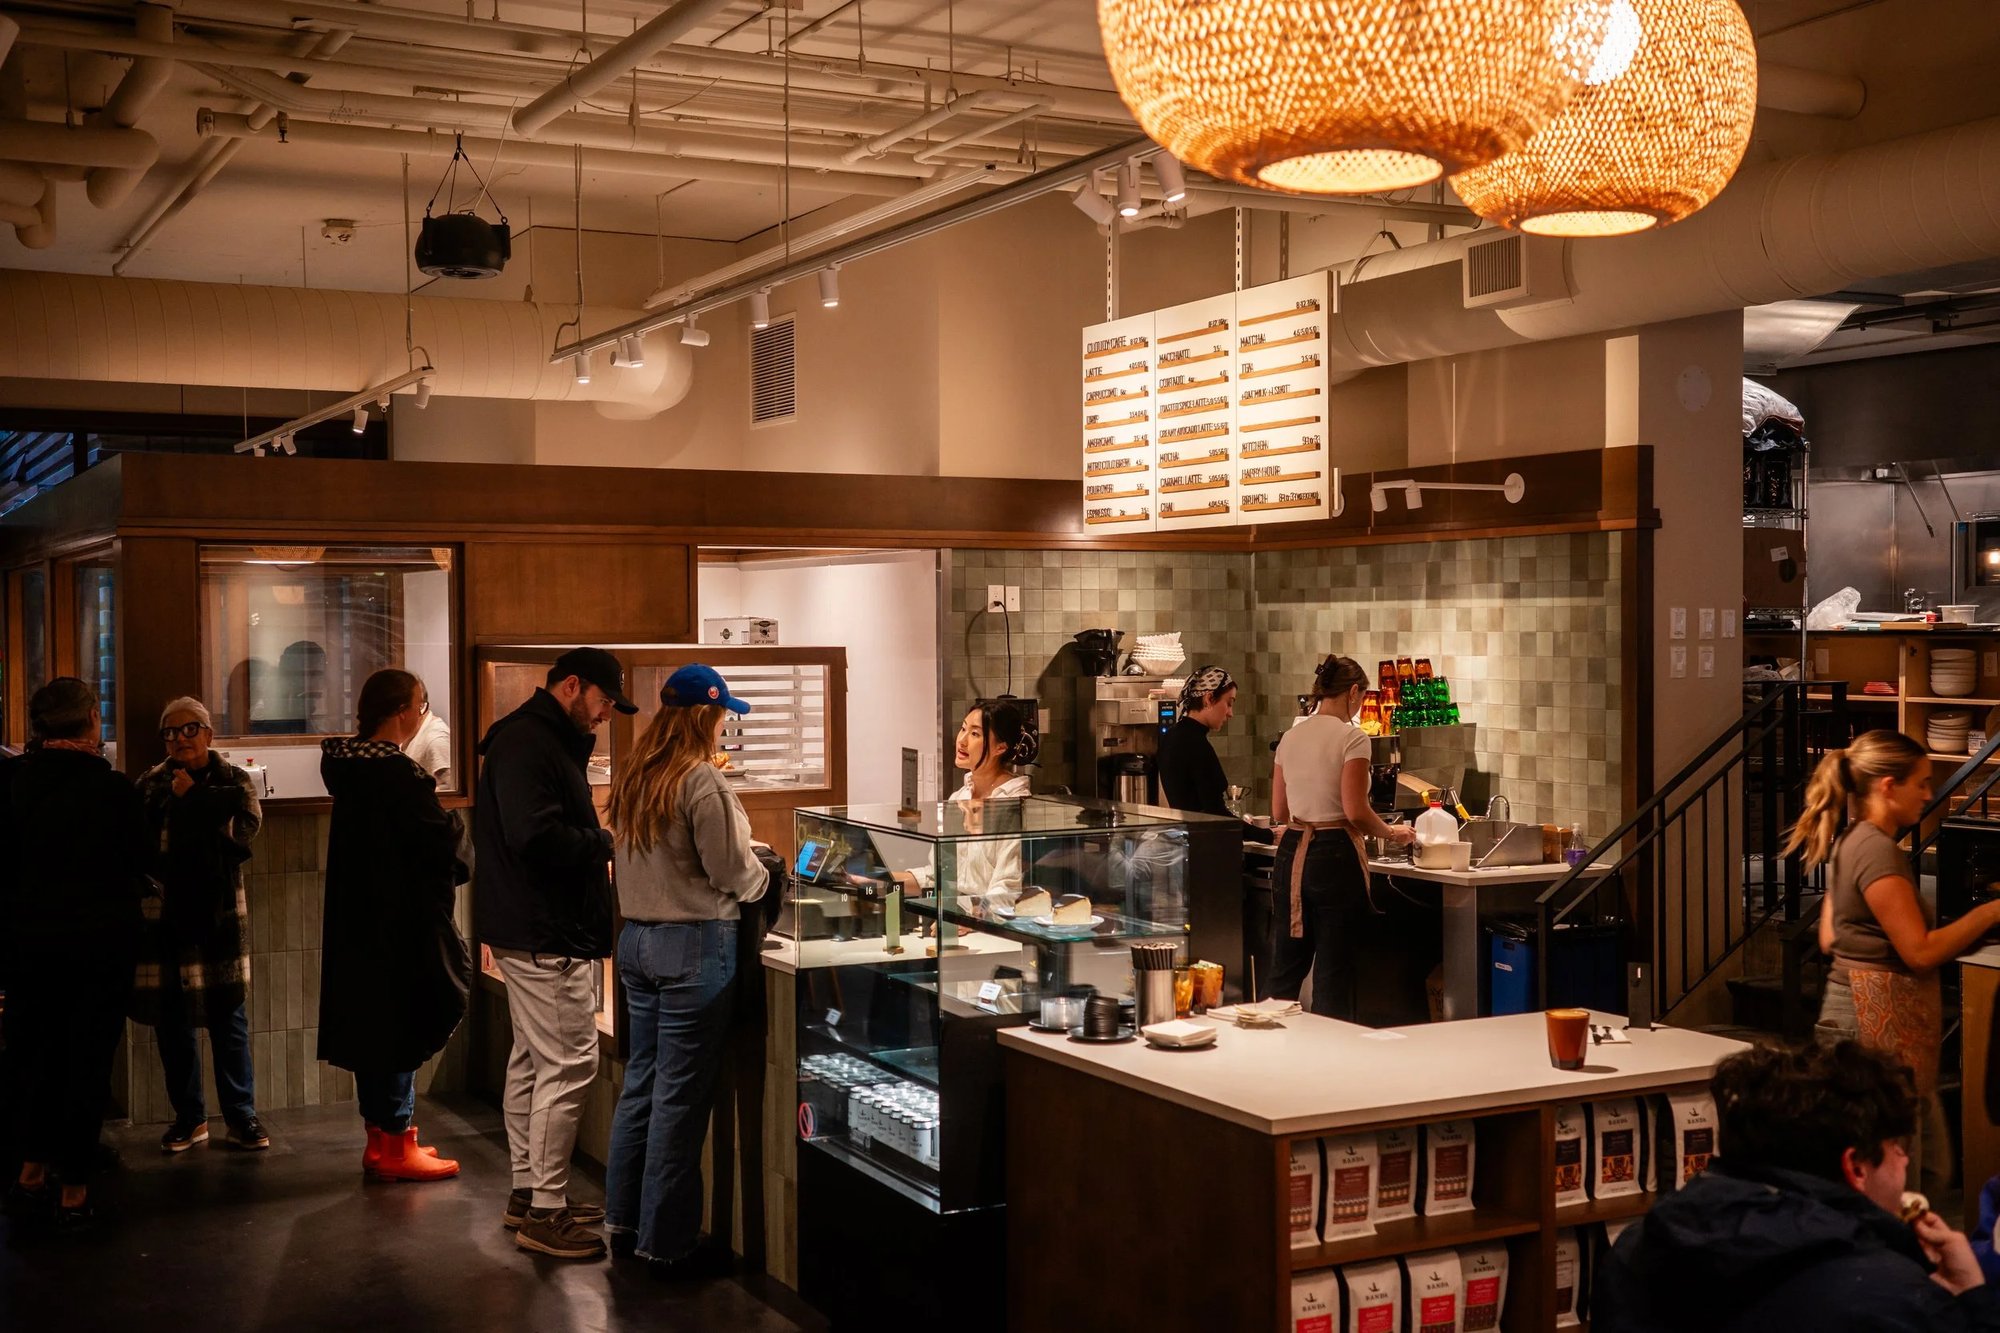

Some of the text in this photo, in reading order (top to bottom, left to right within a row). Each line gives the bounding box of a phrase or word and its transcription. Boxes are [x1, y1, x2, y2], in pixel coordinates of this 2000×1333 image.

[1240, 333, 1266, 347] MATCHA
[1086, 367, 1102, 378] LATTE
[1242, 363, 1253, 374] TEA
[1159, 375, 1184, 388] CORTADO
[1193, 398, 1206, 409] LATTE
[1086, 414, 1099, 424] DRIP
[1177, 425, 1197, 436] AVOCADO
[1198, 422, 1213, 432] LATTE
[1087, 436, 1115, 448] AMERICANO
[1242, 440, 1268, 453] KITCHEN
[1160, 451, 1179, 463] MOCHA
[1102, 460, 1115, 470] COLD
[1242, 465, 1281, 479] HAPPY HOUR
[1160, 476, 1184, 487] CARAMEL
[1185, 474, 1202, 484] LATTE
[1242, 494, 1268, 505] BRUNCH
[1160, 502, 1174, 512] CHAI
[1086, 508, 1112, 518] ESPRESSO
[865, 886, 873, 895] 16
[926, 890, 933, 899] 17
[841, 893, 848, 903] 10
